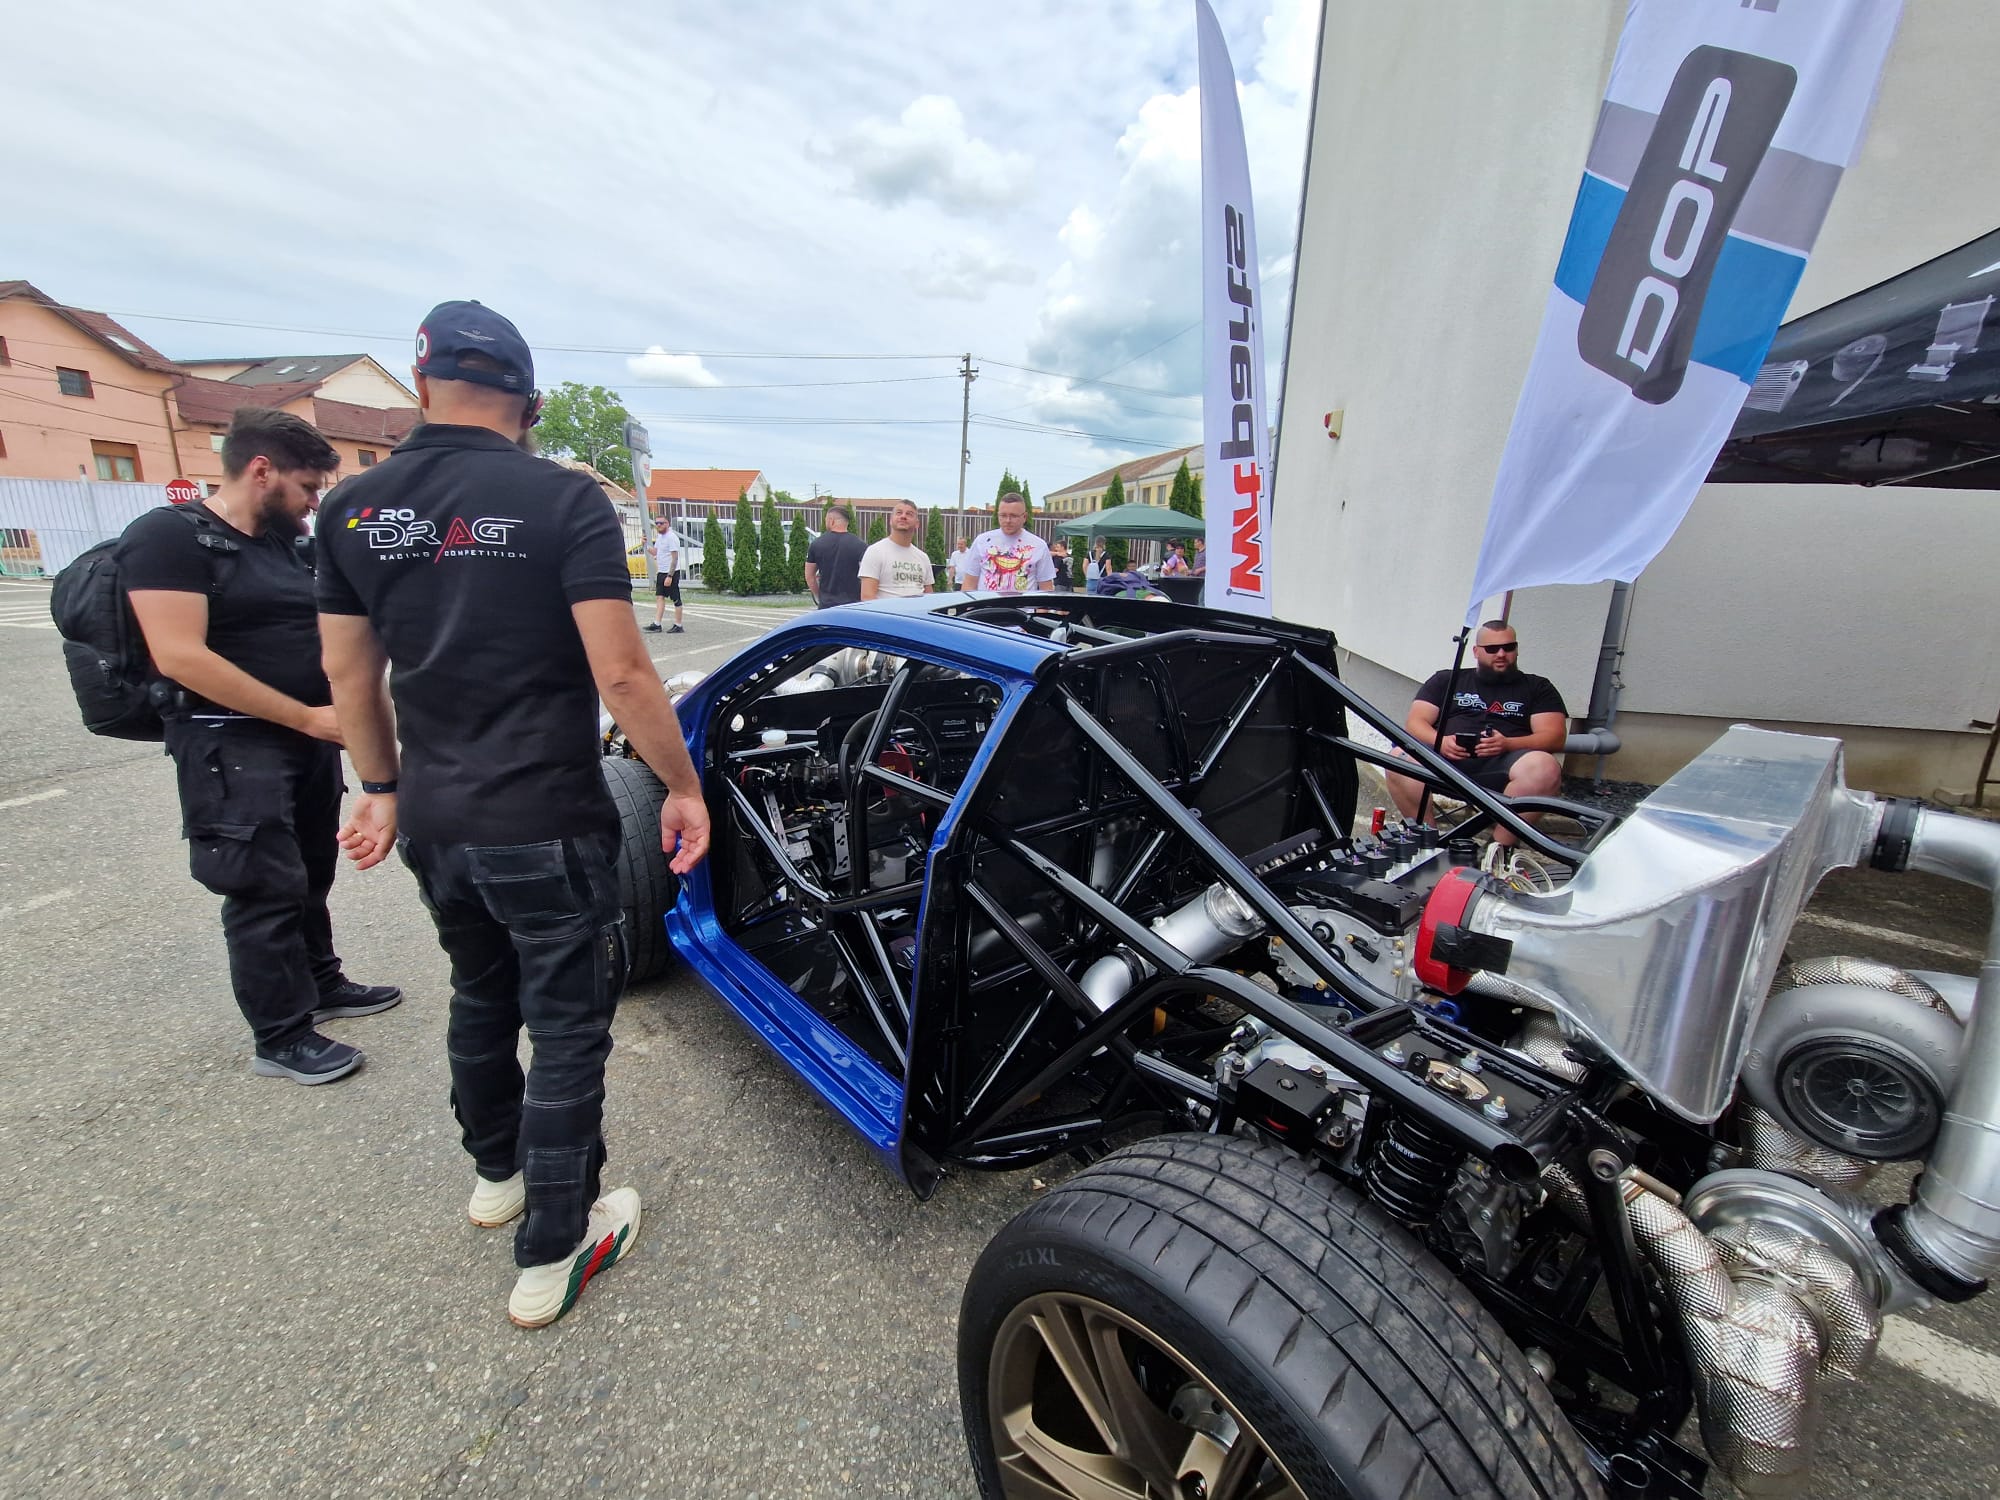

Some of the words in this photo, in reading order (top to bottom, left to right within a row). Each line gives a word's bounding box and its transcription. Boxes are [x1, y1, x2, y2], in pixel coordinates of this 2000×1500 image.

[1615, 77, 1732, 372] DOP
[166, 487, 199, 500] STOP
[379, 508, 415, 521] RO
[356, 517, 524, 564] DRAG
[380, 552, 430, 561] RACING
[444, 550, 527, 559] COMPETITION
[894, 572, 923, 583] JONES
[1453, 698, 1524, 713] DRAG
[1036, 1247, 1062, 1266] XL
